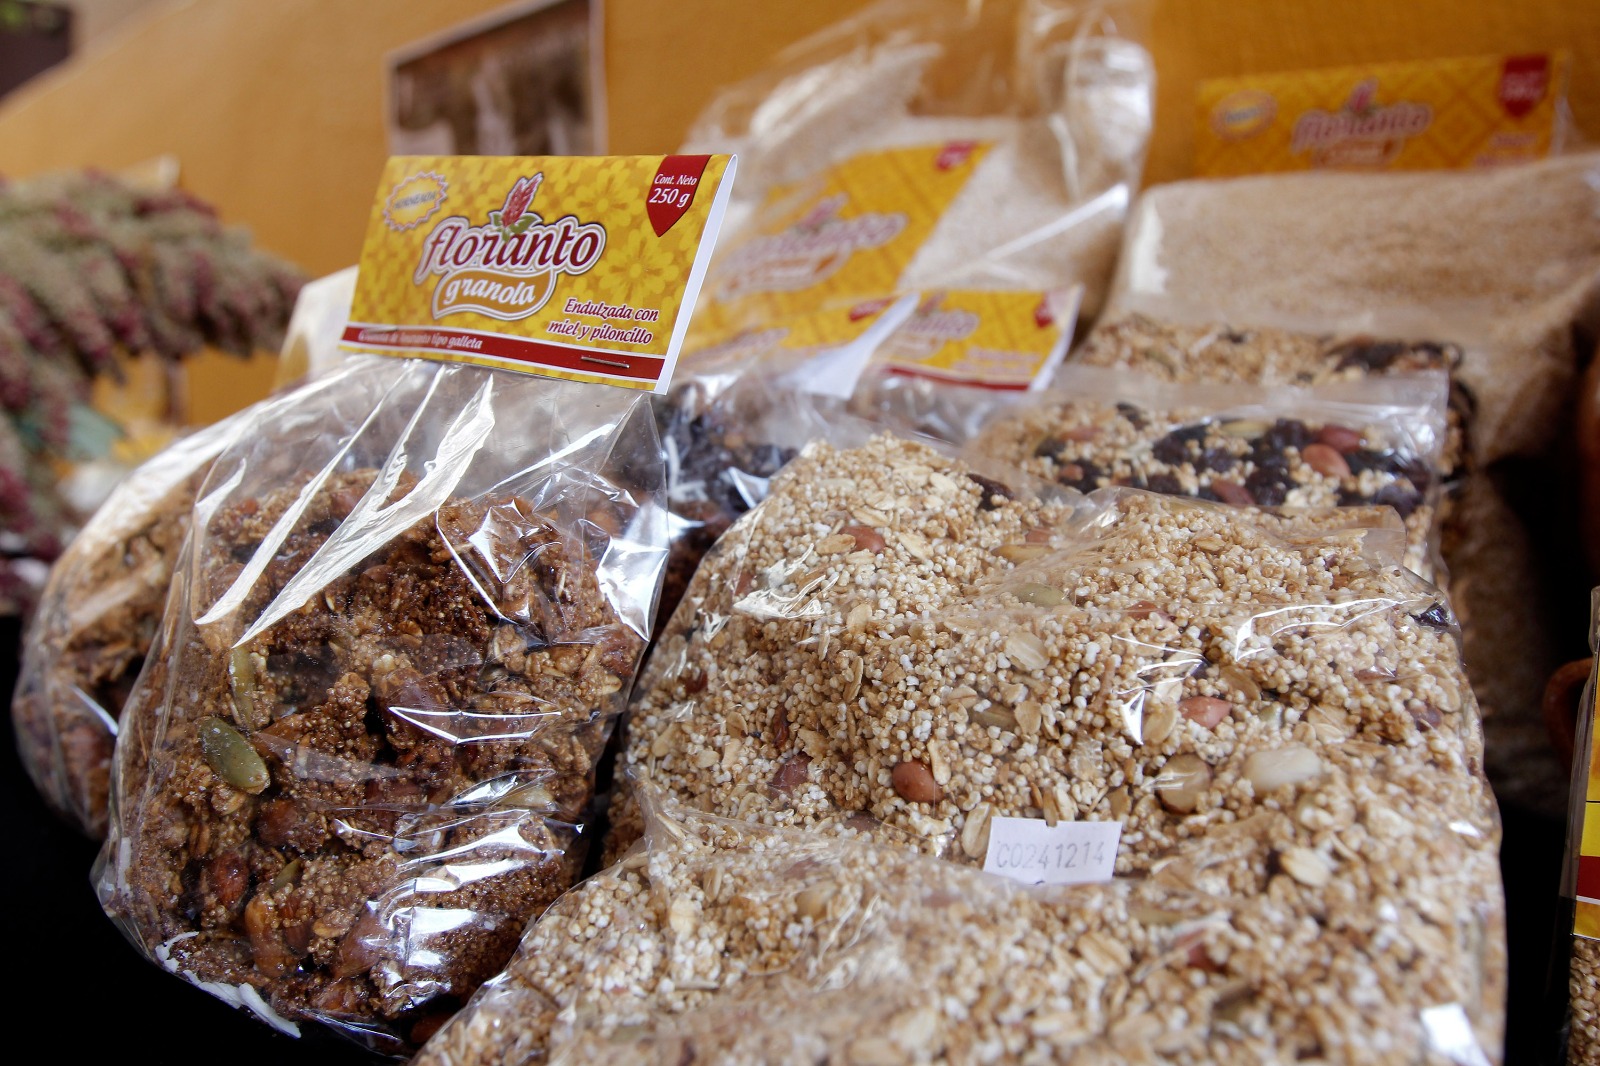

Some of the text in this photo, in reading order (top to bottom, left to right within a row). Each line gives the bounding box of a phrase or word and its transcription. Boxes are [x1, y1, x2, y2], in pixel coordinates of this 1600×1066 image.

[654, 173, 698, 186] Cont. Neto
[649, 187, 691, 208] 250 g
[420, 223, 601, 275] floranto
[442, 277, 536, 306] granola
[564, 297, 660, 322] Endulzada con
[430, 332, 449, 347] tipo
[448, 335, 483, 350] galleta
[547, 319, 653, 344] miel y piloncillo
